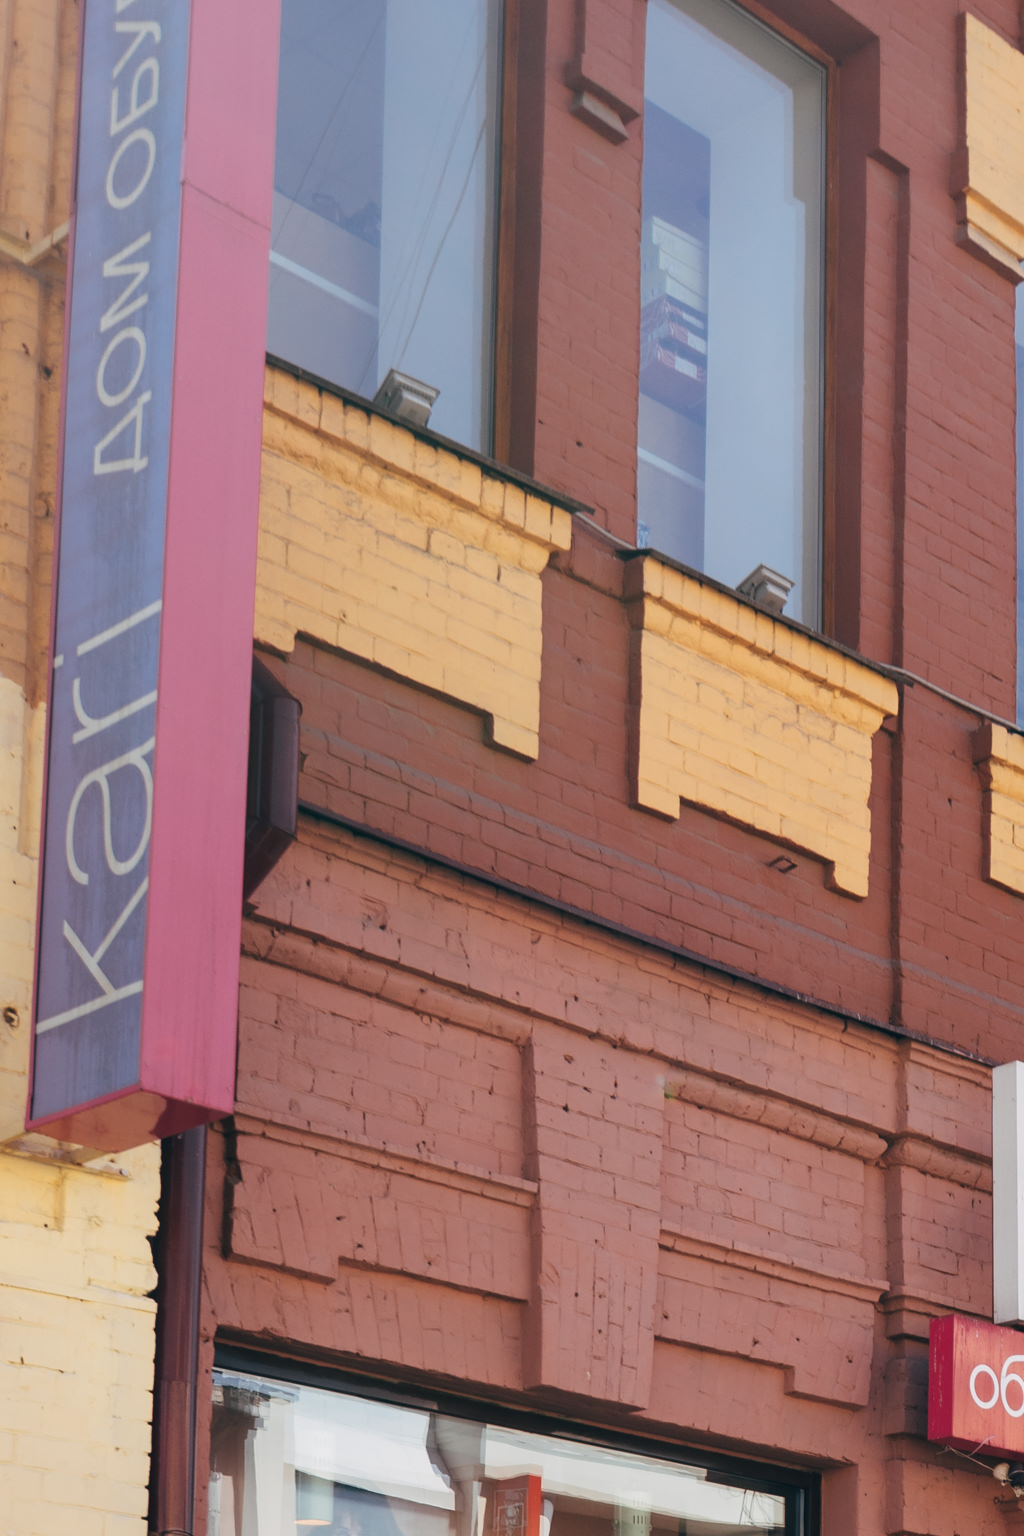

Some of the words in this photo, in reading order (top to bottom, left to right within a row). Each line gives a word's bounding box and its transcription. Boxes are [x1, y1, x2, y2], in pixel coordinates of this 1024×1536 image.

[105, 0, 162, 209] ОБУ
[94, 232, 151, 476] ДОМ
[34, 600, 164, 1035] kari
